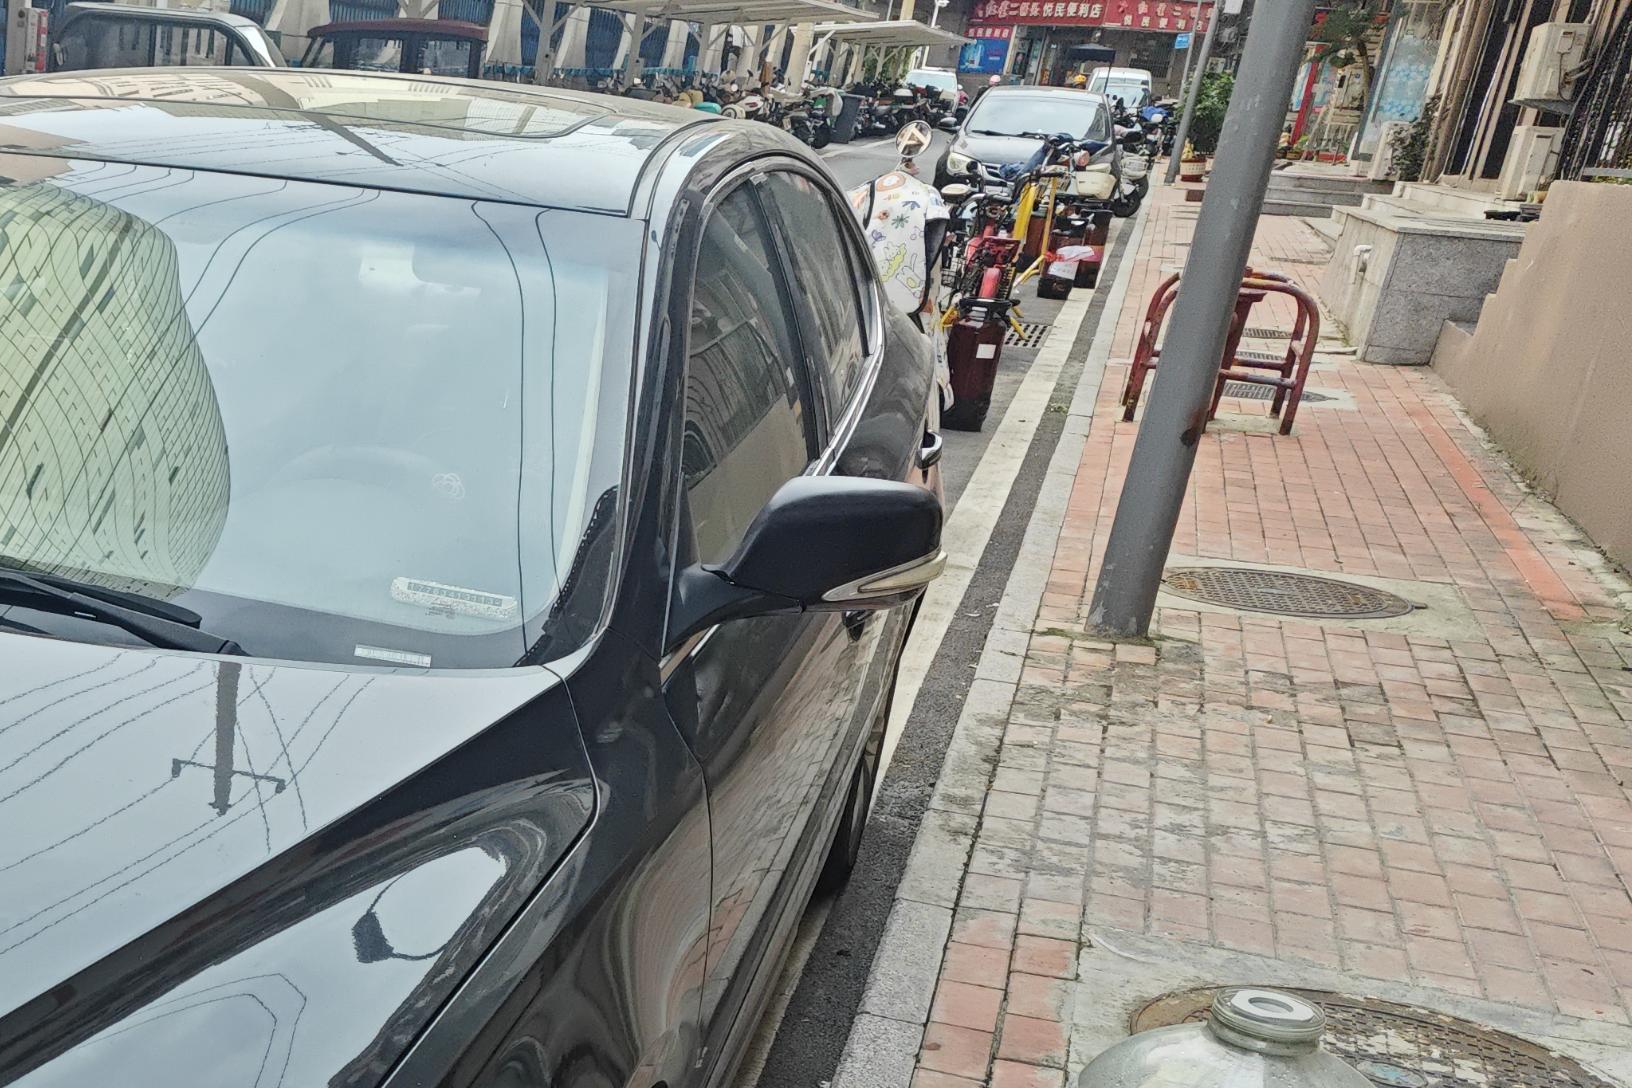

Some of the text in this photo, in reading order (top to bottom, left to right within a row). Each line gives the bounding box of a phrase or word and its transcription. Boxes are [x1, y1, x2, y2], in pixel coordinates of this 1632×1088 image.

[1042, 1, 1103, 18] 悦民便利店
